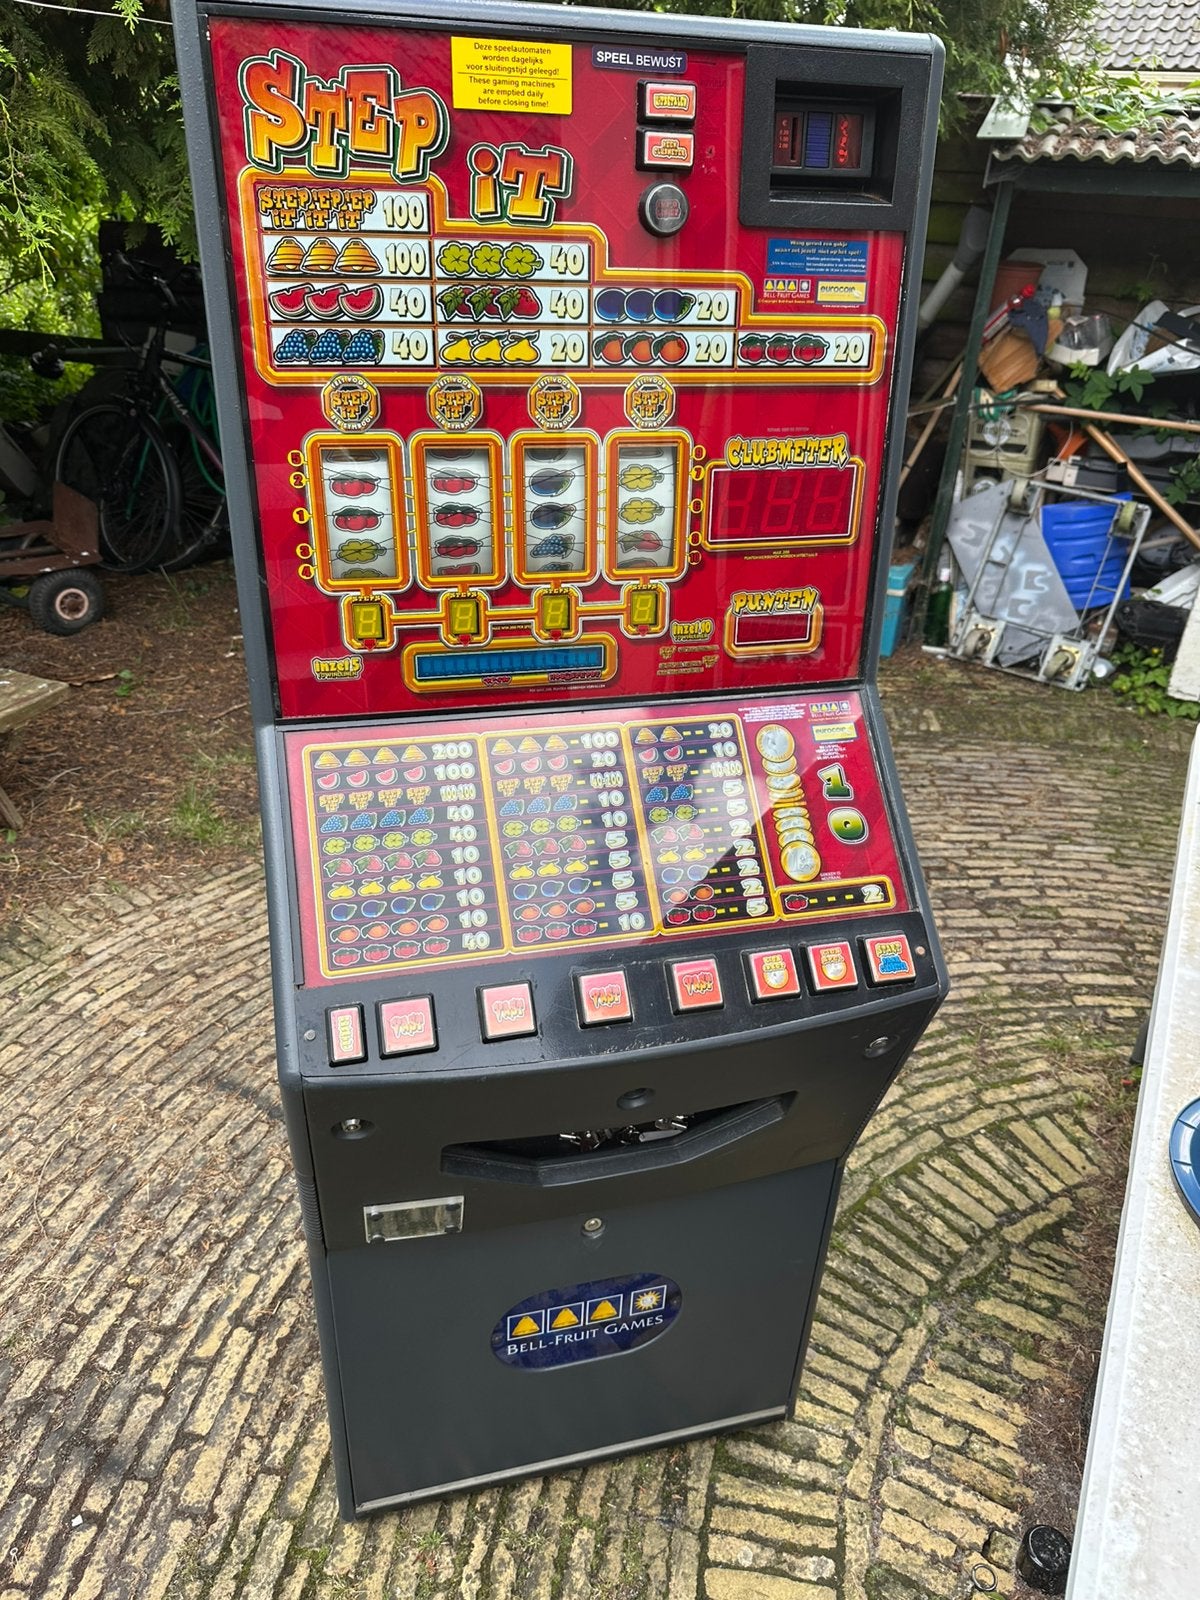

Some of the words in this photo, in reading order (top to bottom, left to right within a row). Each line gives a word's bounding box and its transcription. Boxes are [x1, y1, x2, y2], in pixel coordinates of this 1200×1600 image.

[474, 42, 492, 51] Deze
[494, 44, 551, 55] speelautomaten
[511, 56, 543, 65] dagelijks
[597, 51, 633, 65] SPEEL
[636, 54, 682, 68] BEWUST
[485, 64, 527, 74] sluitingstijd
[529, 67, 559, 76] geleegd!
[468, 76, 490, 84] These
[493, 78, 519, 88] gaming
[521, 79, 555, 88] machines
[496, 88, 524, 97] emptied
[527, 89, 544, 99] daily
[503, 98, 529, 108] closing
[531, 99, 549, 107] time!
[241, 52, 446, 181] STEP
[383, 195, 424, 229] 100
[385, 242, 426, 274] 100
[550, 245, 584, 274] 40
[390, 288, 425, 318] 40
[550, 290, 584, 319] 40
[697, 292, 729, 321] 20
[393, 331, 428, 361] 40
[551, 333, 585, 362] 20
[695, 334, 727, 363] 20
[834, 335, 864, 363] 20
[331, 390, 370, 407] STEP
[436, 390, 473, 408] STEP
[536, 390, 572, 407] STEP
[632, 390, 668, 407] STEP
[290, 452, 301, 464] 5
[728, 435, 847, 467] CLUBMETER
[293, 474, 303, 486] 2
[296, 510, 304, 521] 1
[299, 545, 309, 558] 3
[302, 566, 311, 578] 4
[732, 587, 818, 614] PUNTEN
[701, 620, 711, 634] 10
[351, 657, 360, 671] 5
[708, 722, 733, 739] 20
[581, 731, 619, 749] 100
[712, 741, 737, 757] 10
[432, 741, 473, 760] 200
[591, 750, 617, 768] 20
[434, 762, 476, 781] 100
[722, 779, 744, 797] 5
[817, 762, 854, 800] 1
[598, 789, 624, 807] 10
[447, 804, 474, 821] 40
[727, 799, 748, 817] 5
[601, 810, 628, 828] 10
[729, 819, 751, 836] 2
[449, 824, 477, 842] 40
[605, 830, 628, 849] 5
[451, 845, 480, 864] 10
[733, 838, 756, 856] 2
[609, 850, 631, 869] 5
[737, 858, 760, 876] 2
[454, 866, 482, 885] 10
[612, 870, 635, 890] 5
[741, 878, 764, 897] 2
[861, 884, 884, 903] 2
[456, 887, 485, 907] 10
[615, 891, 638, 911] 5
[746, 897, 768, 917] 5
[459, 908, 488, 928] 10
[618, 912, 645, 931] 10
[462, 931, 490, 950] 40
[507, 1328, 599, 1355] BELL-FRUIT
[604, 1314, 664, 1335] GAMES
